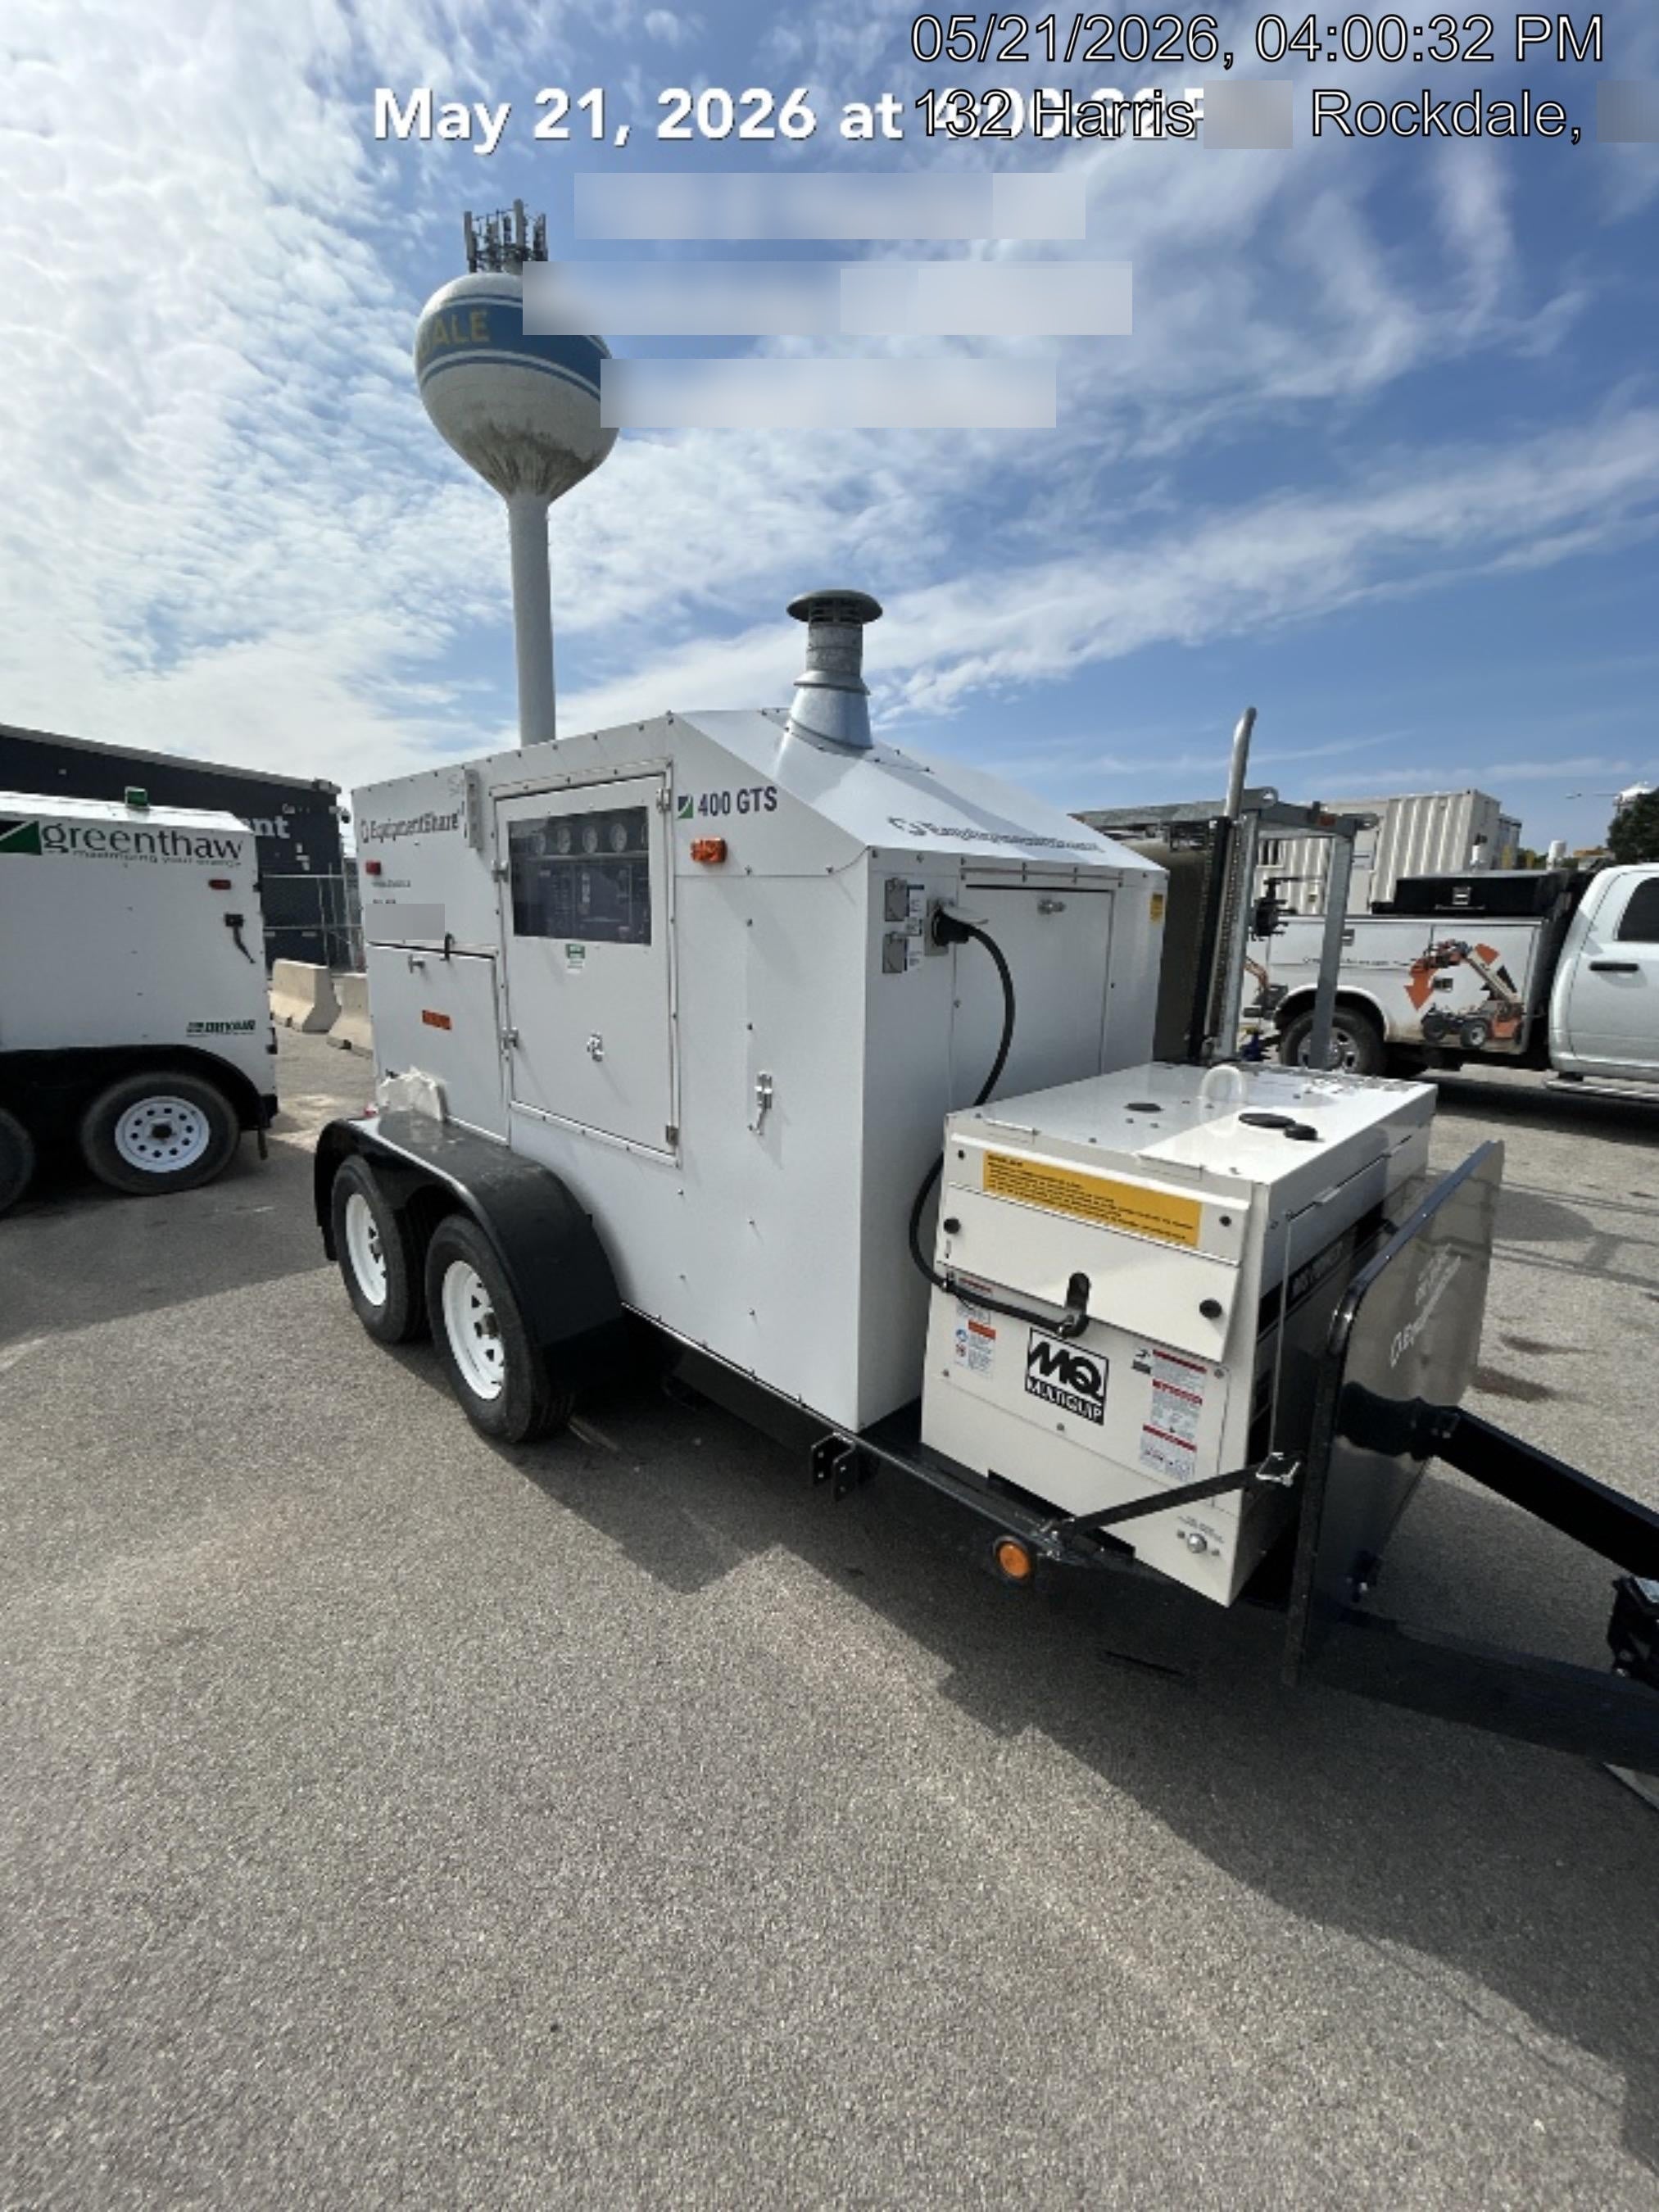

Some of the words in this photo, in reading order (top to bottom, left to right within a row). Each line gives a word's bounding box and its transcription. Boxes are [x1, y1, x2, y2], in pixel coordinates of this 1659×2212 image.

[697, 791, 731, 816] 400
[737, 786, 777, 814] GTS
[42, 823, 243, 859] greenthaw
[1028, 1342, 1104, 1401] MQ
